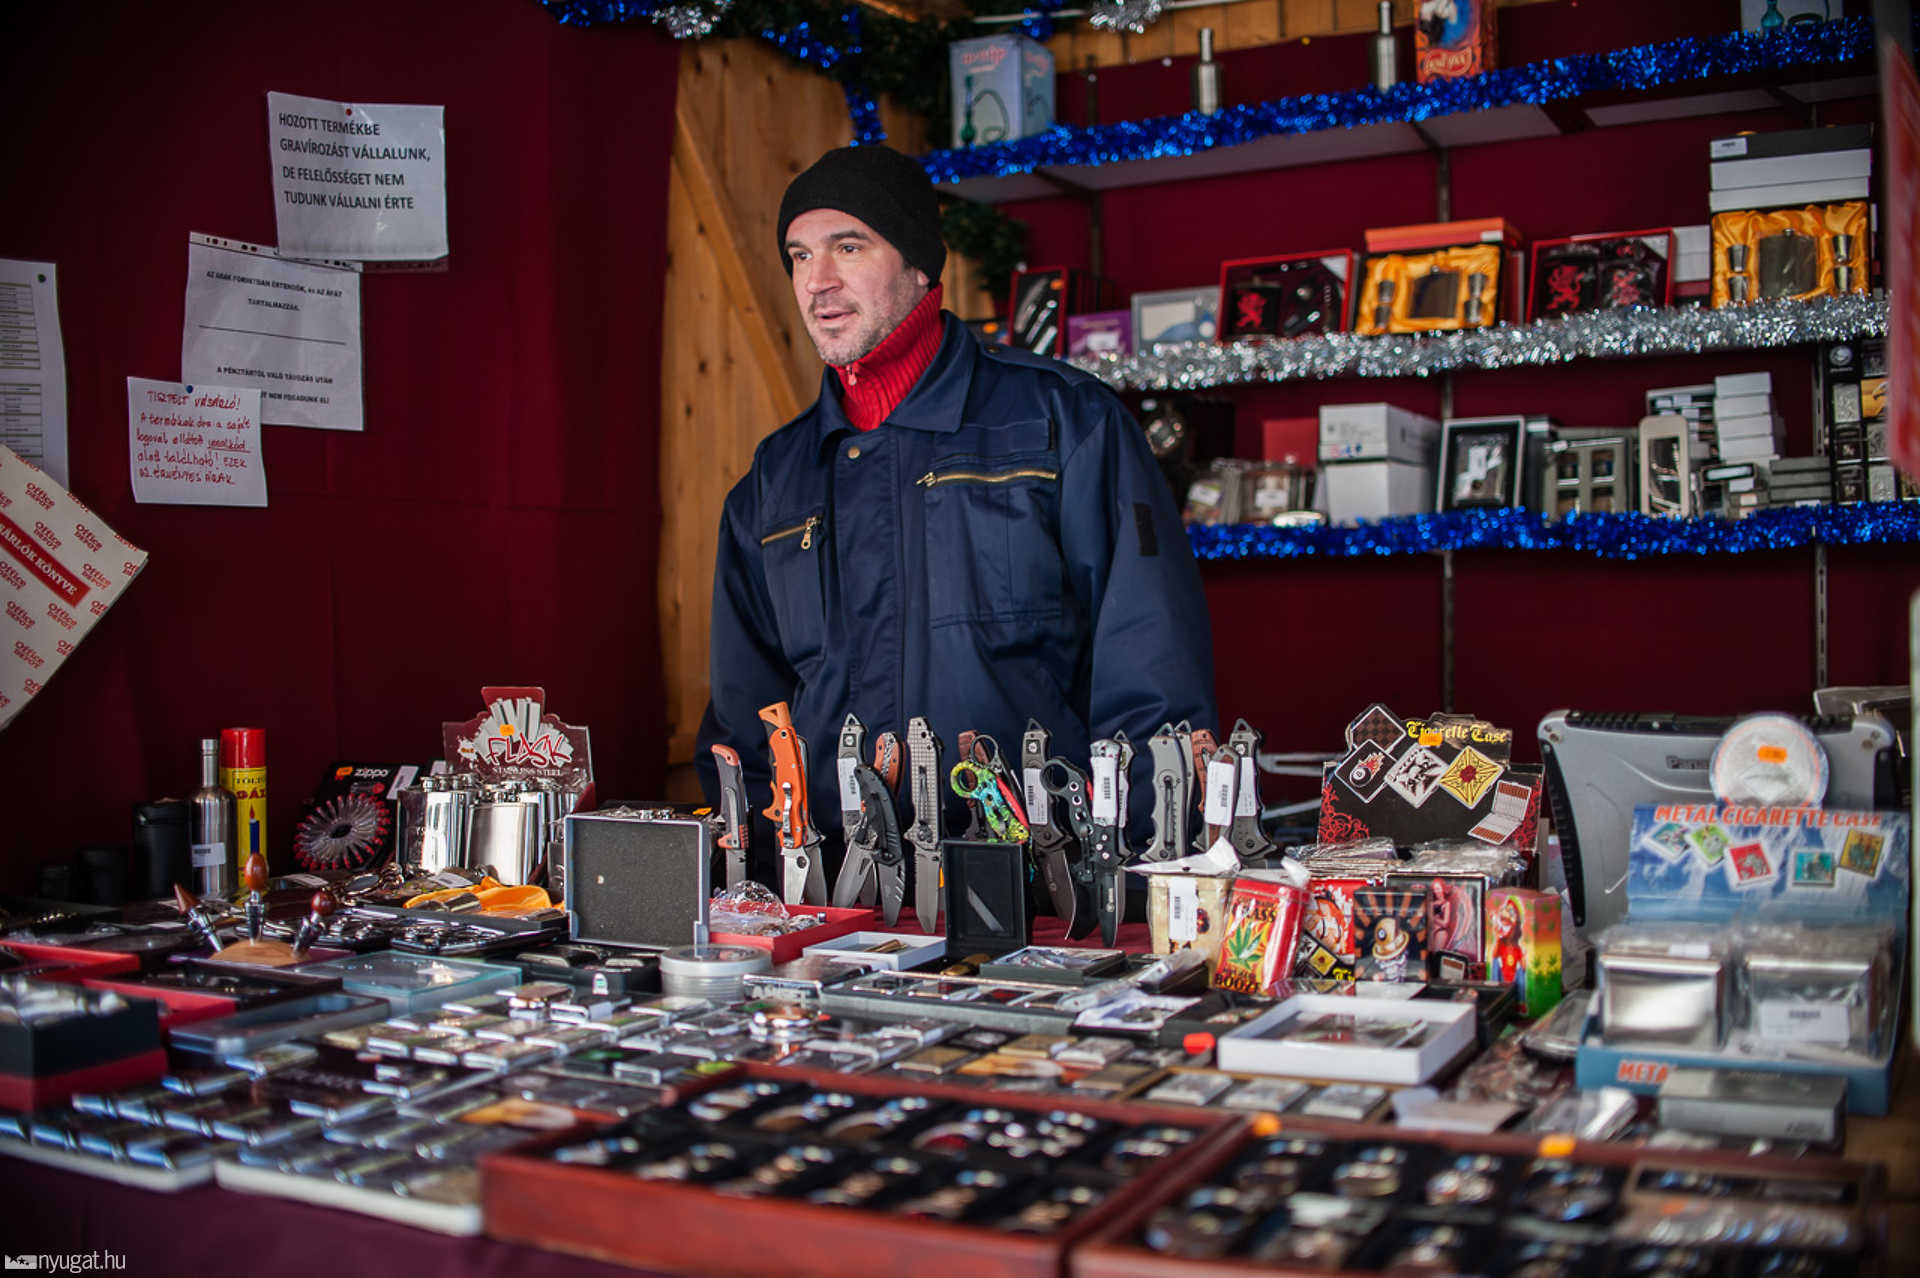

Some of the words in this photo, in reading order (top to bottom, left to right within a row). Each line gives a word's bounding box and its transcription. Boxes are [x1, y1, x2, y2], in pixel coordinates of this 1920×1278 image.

[279, 112, 319, 131] HOZOTT
[322, 118, 381, 136] TERMÉKBE
[280, 137, 349, 158] GRAVÍROZÁST
[352, 144, 431, 162] VÁLLALUNK,
[282, 166, 296, 179] DE
[375, 173, 405, 185] NEM
[284, 190, 327, 206] TUDUNK
[329, 192, 381, 209] VÁLLALNI
[384, 194, 414, 209] ÉRTE
[26, 482, 55, 506] Office
[35, 521, 62, 546] Office
[75, 524, 102, 549] Office
[83, 563, 112, 587] Office
[7, 600, 35, 625] Office
[48, 603, 77, 626] Office
[15, 640, 45, 664] Office
[486, 732, 572, 766] FLASK
[354, 767, 389, 779] zippo
[1653, 803, 1717, 824] METAL
[1721, 806, 1828, 828] CIGARETTE
[1617, 1060, 1677, 1084] META
